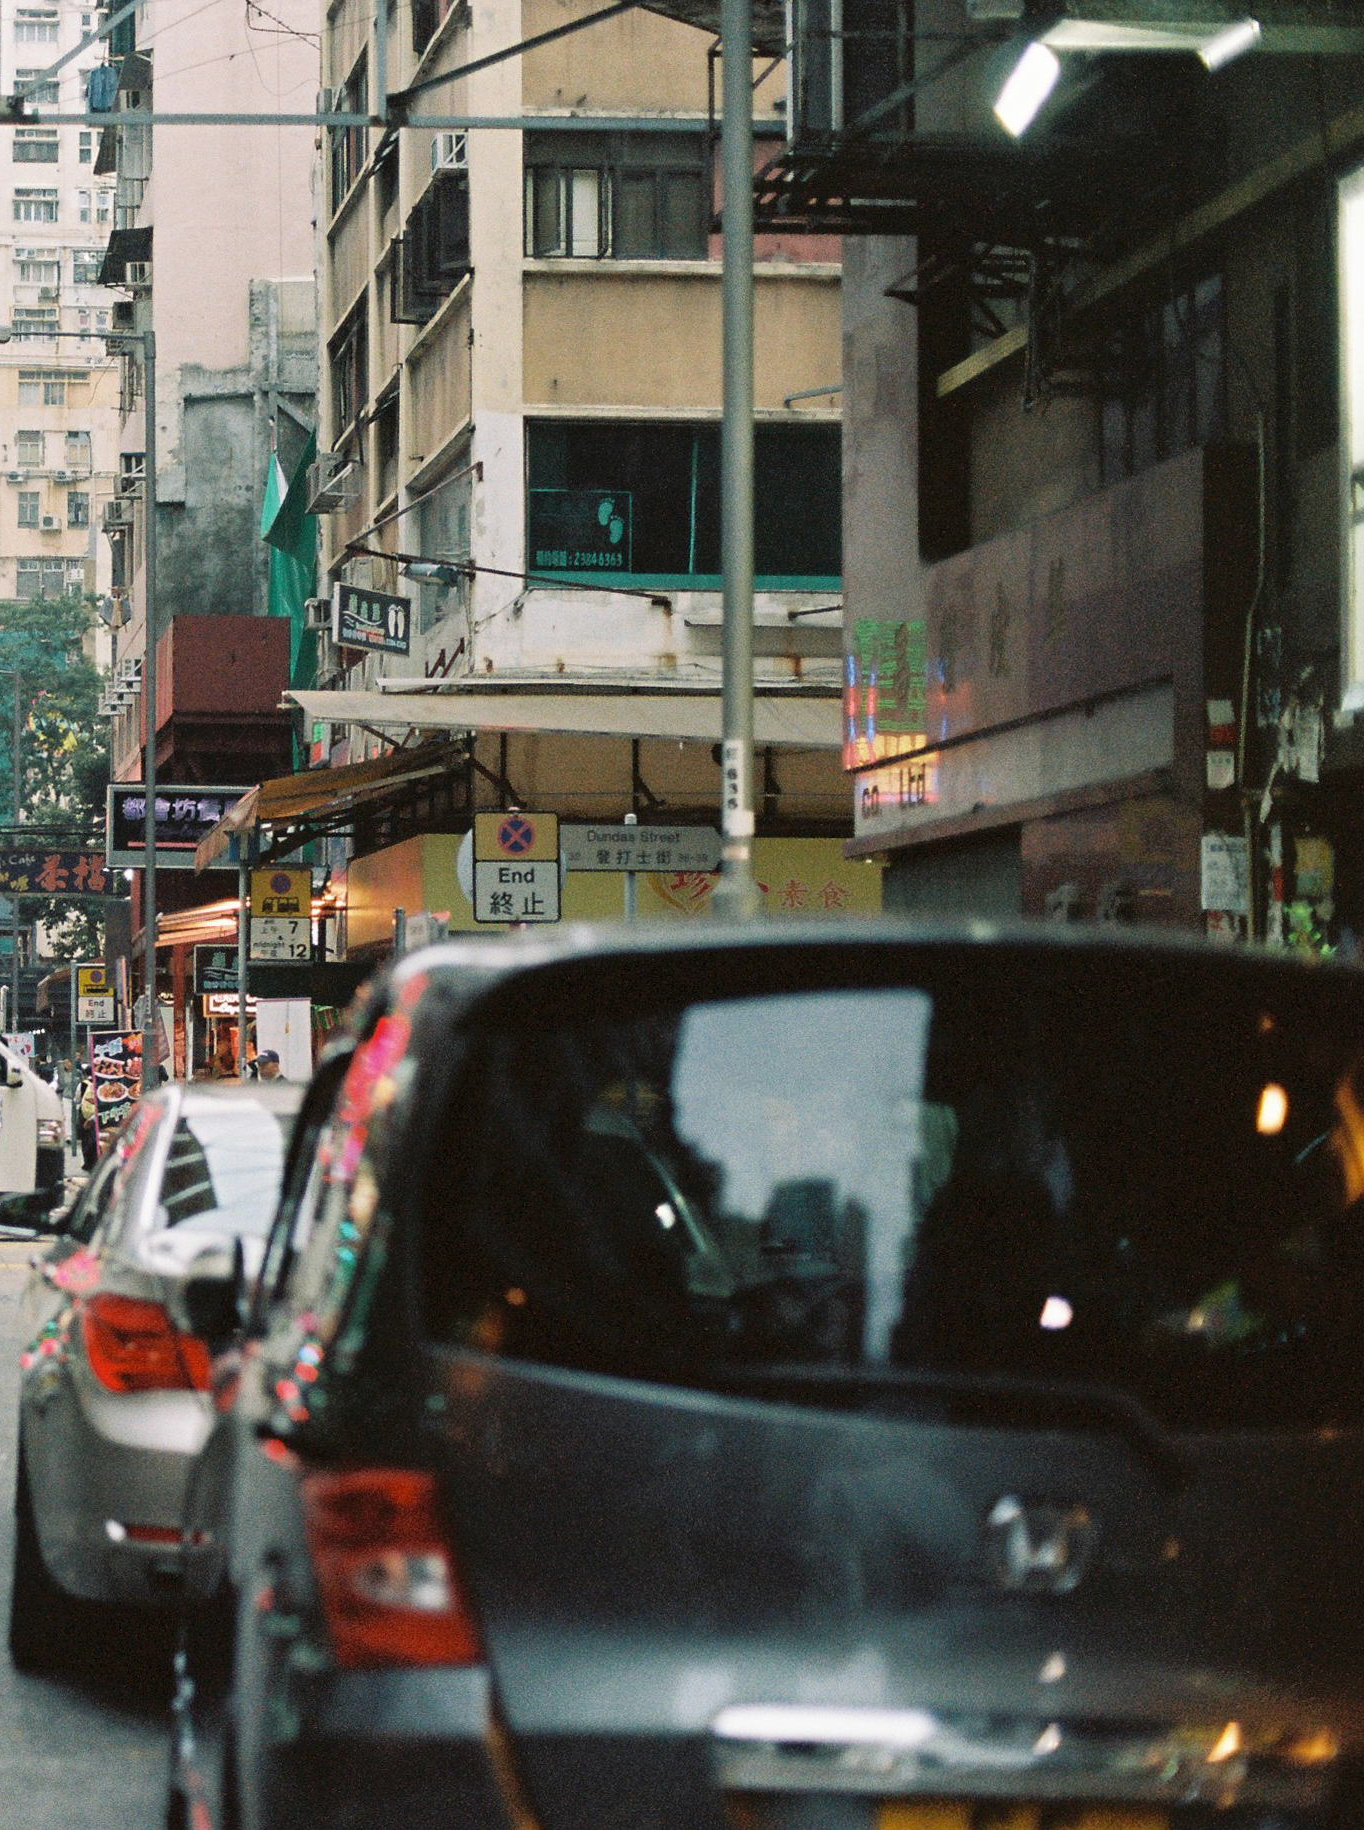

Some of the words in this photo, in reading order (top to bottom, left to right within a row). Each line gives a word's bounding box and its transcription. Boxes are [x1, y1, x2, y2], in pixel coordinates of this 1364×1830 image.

[587, 830, 636, 842] Dundas
[640, 831, 680, 842] Street
[596, 849, 672, 864] 登打士街
[498, 867, 535, 884] End
[489, 892, 545, 917] 終止
[288, 921, 299, 934] 7
[253, 941, 285, 949] midnight
[289, 944, 307, 957] 12
[88, 999, 105, 1007] End
